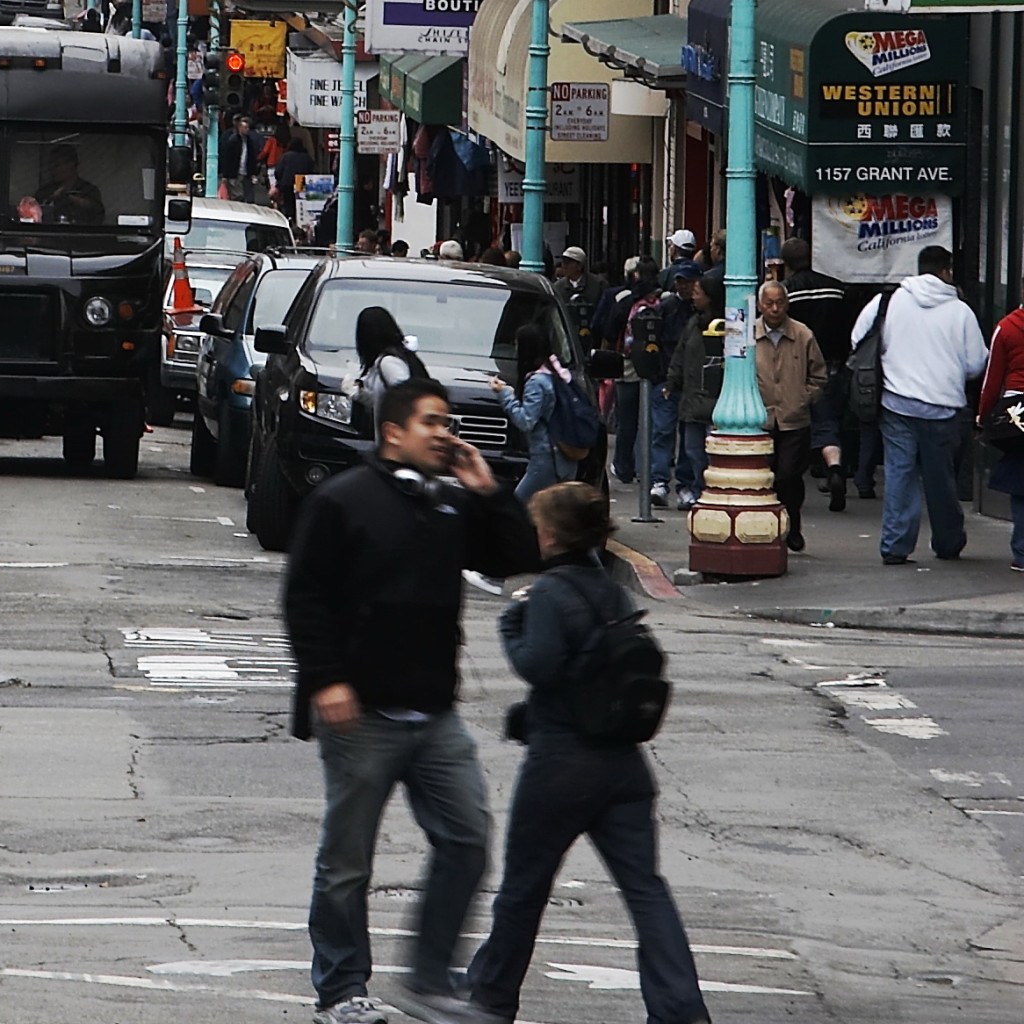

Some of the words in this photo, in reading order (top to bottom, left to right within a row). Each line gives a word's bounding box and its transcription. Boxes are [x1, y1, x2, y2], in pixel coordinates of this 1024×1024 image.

[426, 0, 480, 12] BOUTI
[872, 30, 926, 53] MEGA
[872, 44, 927, 66] MILLIONS
[309, 79, 329, 92] FINE
[552, 84, 570, 100] NO
[571, 87, 608, 100] PARKING
[822, 84, 935, 100] WESTERN
[309, 94, 329, 107] FINE
[857, 101, 935, 116] UNION
[358, 111, 371, 123] NO
[372, 112, 399, 123] PARKING
[816, 168, 852, 182] 1157
[856, 167, 914, 182] GRANT
[917, 167, 953, 182] AVE.
[861, 195, 939, 222] MEGA
[858, 218, 939, 239] MILLIONS
[857, 235, 915, 253] California
